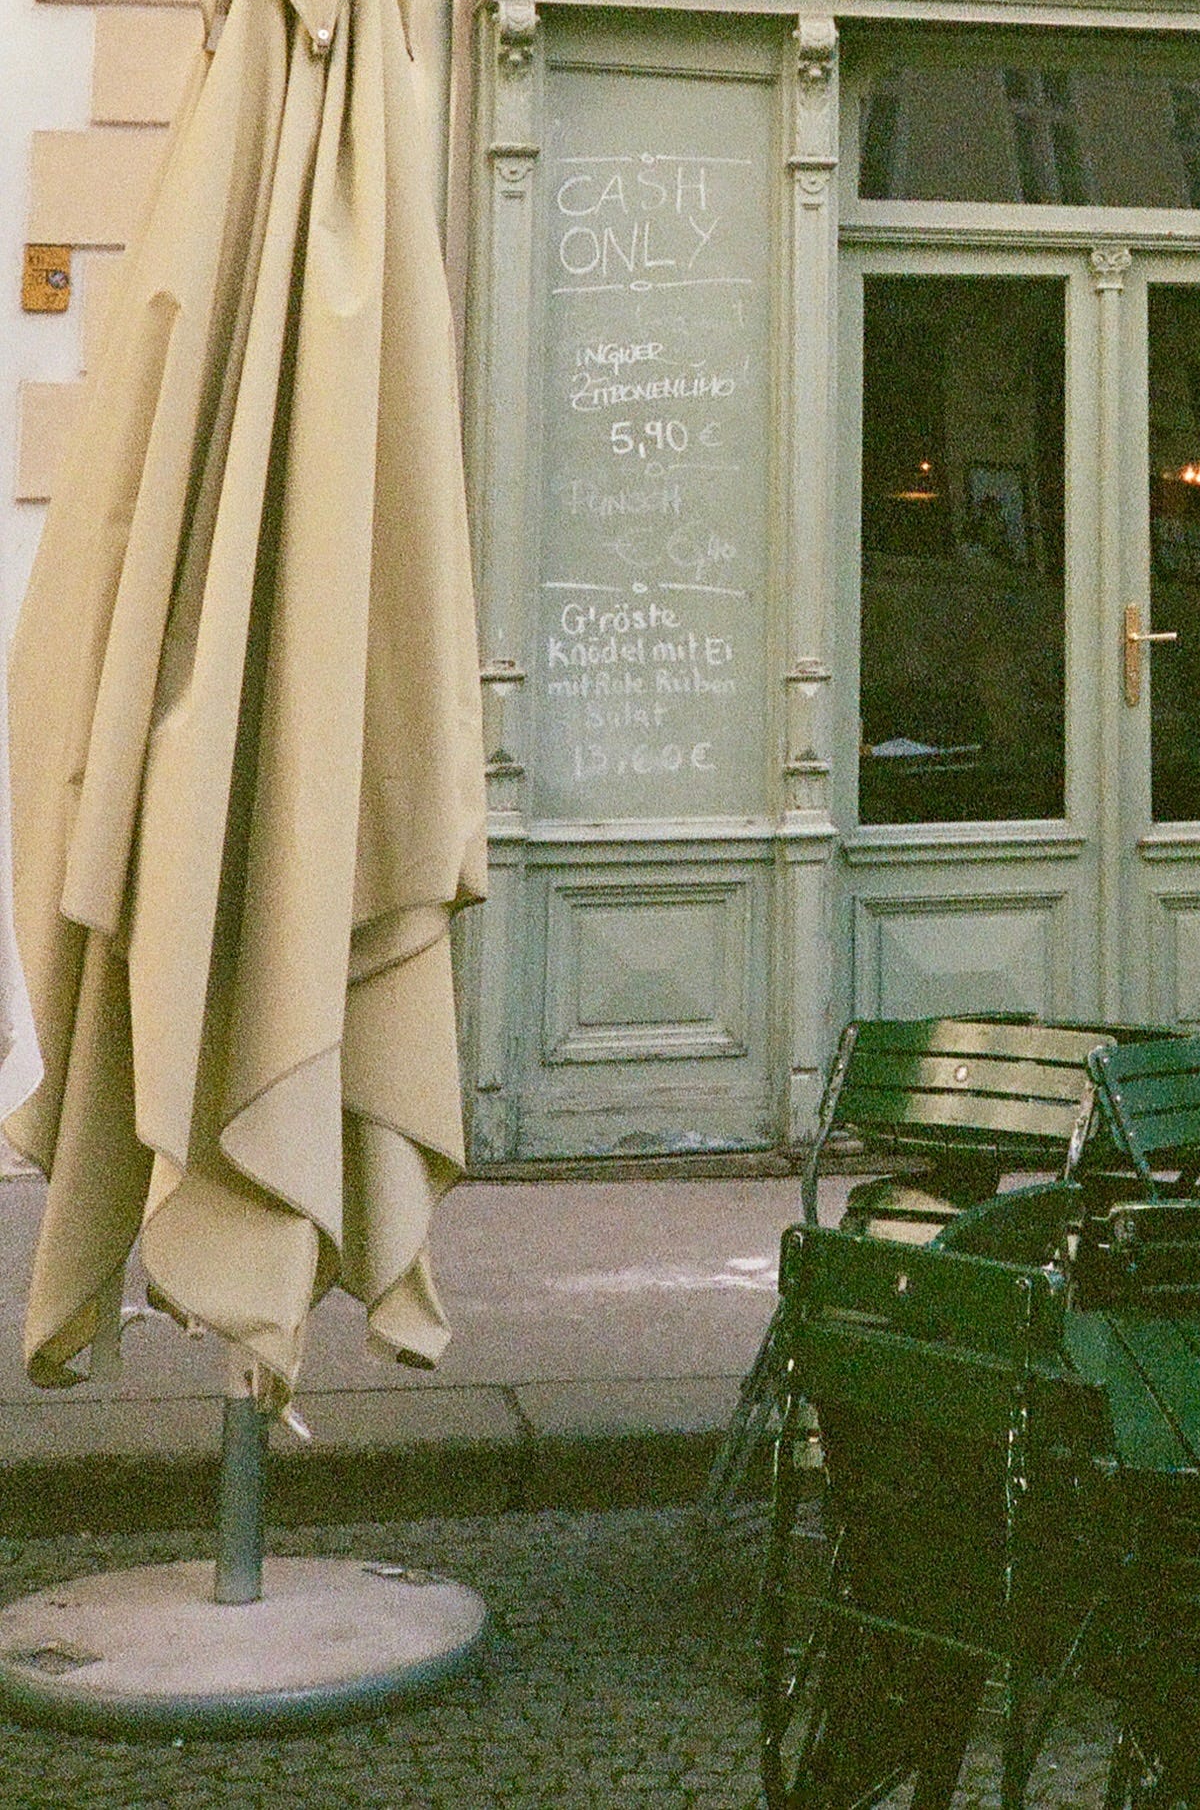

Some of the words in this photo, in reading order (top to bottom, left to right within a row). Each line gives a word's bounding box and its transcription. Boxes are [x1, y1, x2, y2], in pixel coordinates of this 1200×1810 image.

[557, 166, 707, 217] CASH
[559, 216, 720, 275] ONLY
[609, 419, 689, 459] 5,90
[560, 601, 682, 637] G'röste
[547, 634, 646, 668] Knödel
[651, 631, 698, 662] mit
[704, 635, 734, 667] Ei
